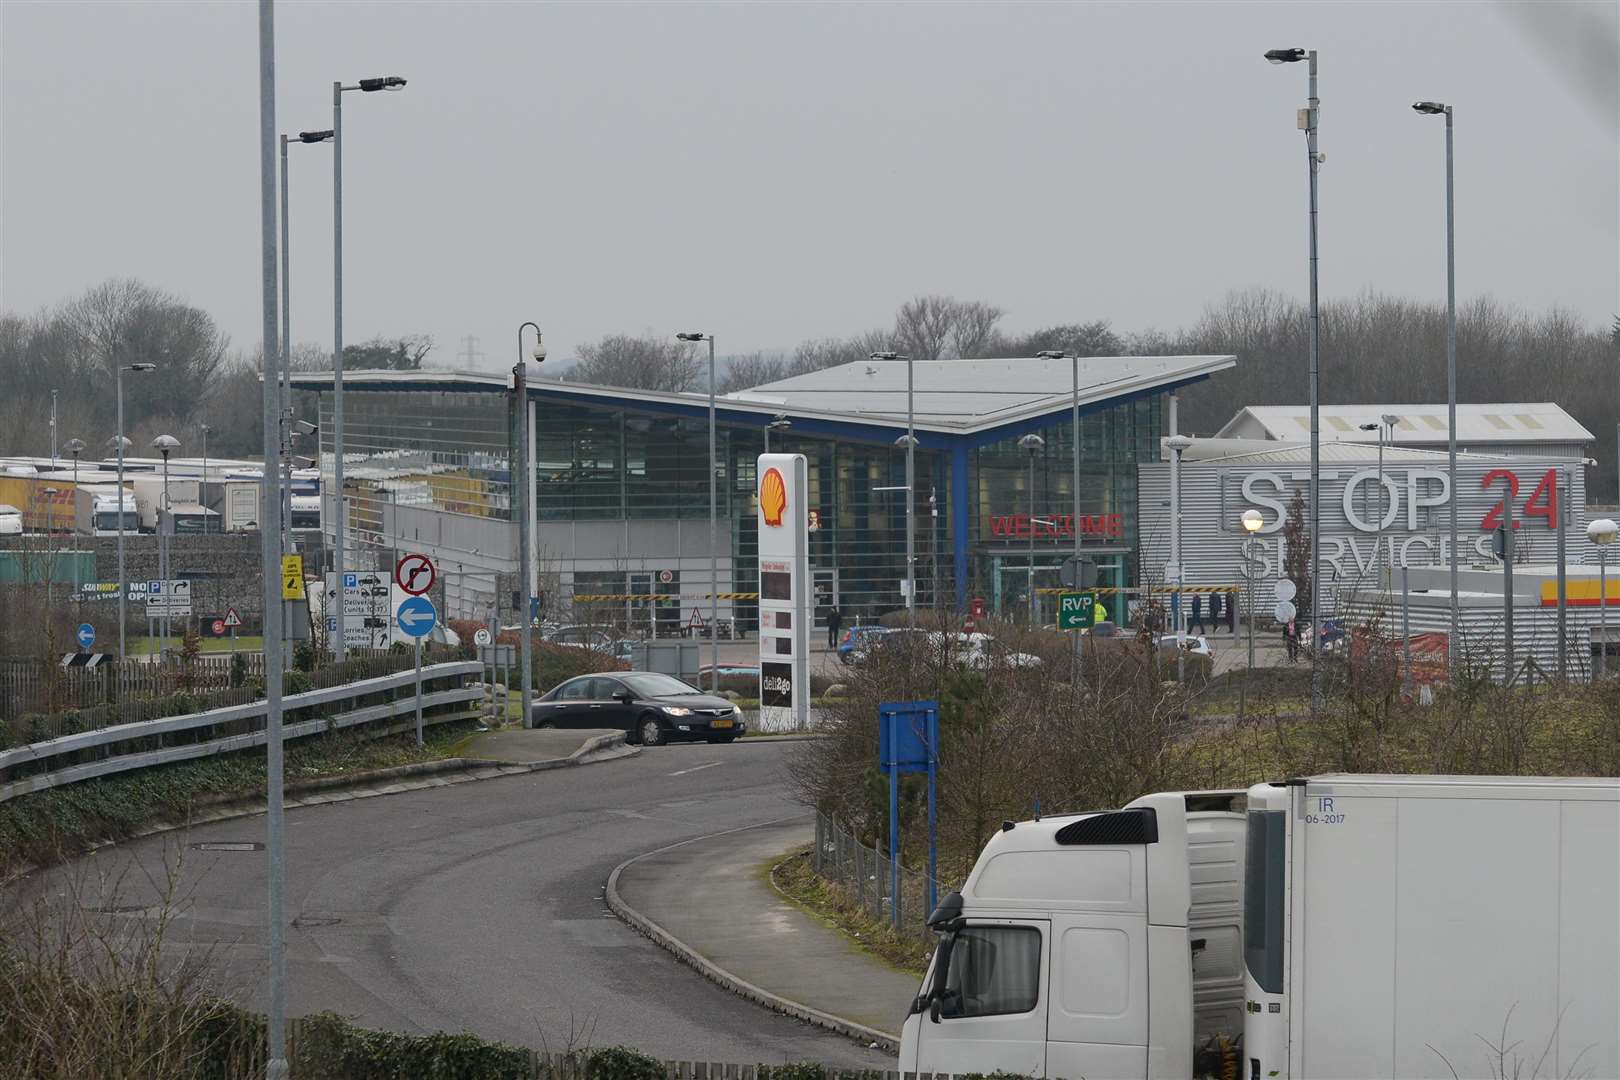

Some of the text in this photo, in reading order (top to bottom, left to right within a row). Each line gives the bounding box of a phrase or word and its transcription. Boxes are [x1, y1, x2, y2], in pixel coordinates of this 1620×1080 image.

[1241, 468, 1557, 534] STOP 24
[990, 511, 1120, 538] WELCOME
[346, 575, 354, 586] P
[128, 592, 147, 601] OP
[1062, 597, 1092, 611] RVP
[763, 675, 790, 695] deli2go
[1319, 797, 1334, 812] IR
